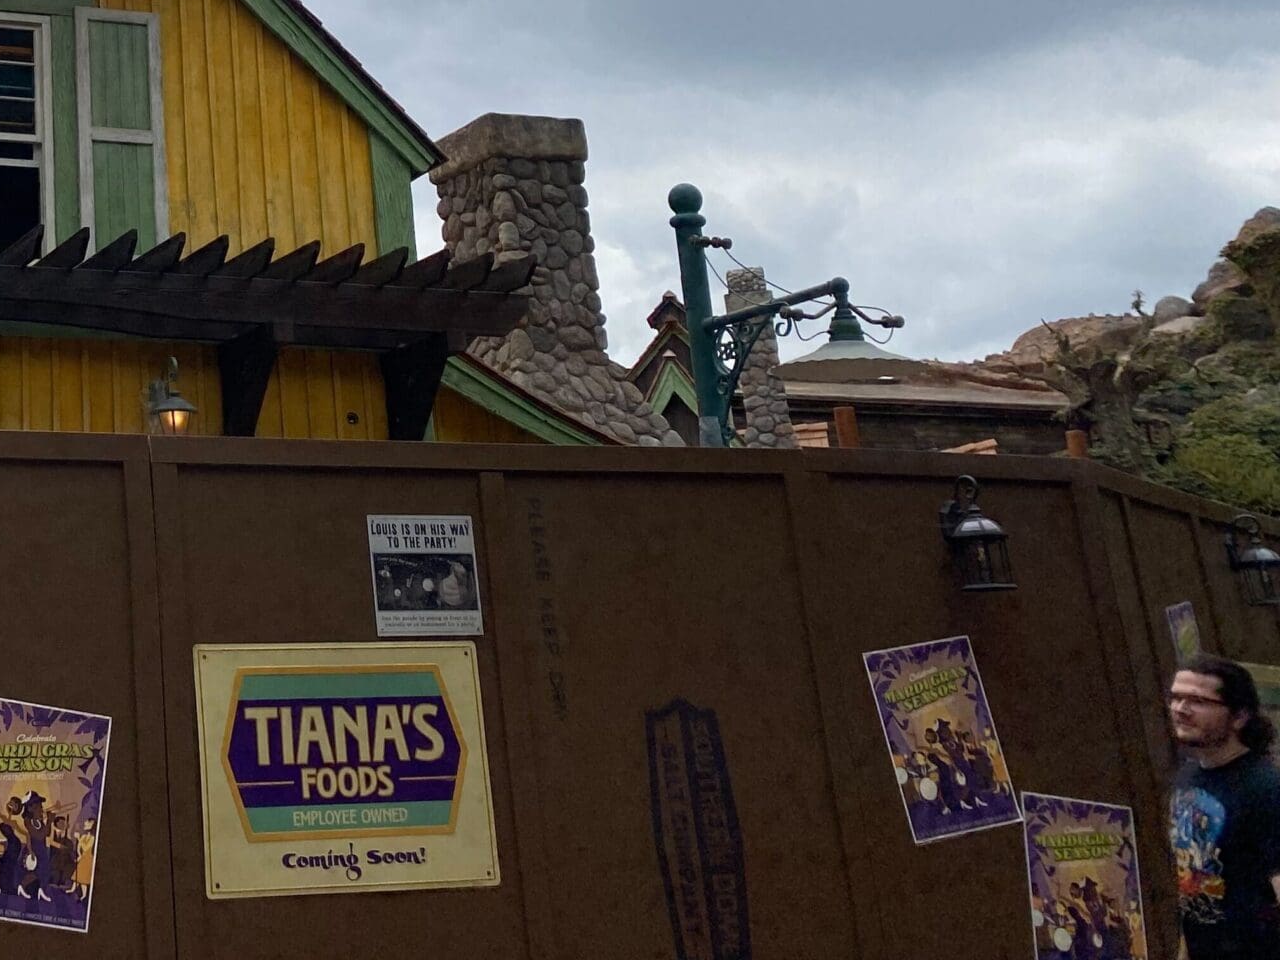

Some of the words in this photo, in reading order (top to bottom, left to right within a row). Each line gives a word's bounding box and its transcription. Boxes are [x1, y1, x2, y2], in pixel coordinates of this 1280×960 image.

[370, 523, 397, 535] LOUIS
[401, 523, 410, 535] IS
[414, 523, 427, 535] ON
[430, 523, 446, 535] HIS
[449, 524, 470, 536] WAY
[387, 536, 400, 548] TO
[404, 536, 421, 548] THE
[424, 536, 457, 549] PARTY!
[902, 680, 958, 713] SEASON
[243, 702, 446, 766] TIANA'S
[42, 743, 95, 759] GRAS
[300, 766, 395, 800] FOODS
[292, 809, 357, 826] EMPLOYEE
[361, 807, 408, 823] OWNED
[282, 842, 362, 881] Coming
[366, 846, 427, 865] Soon!
